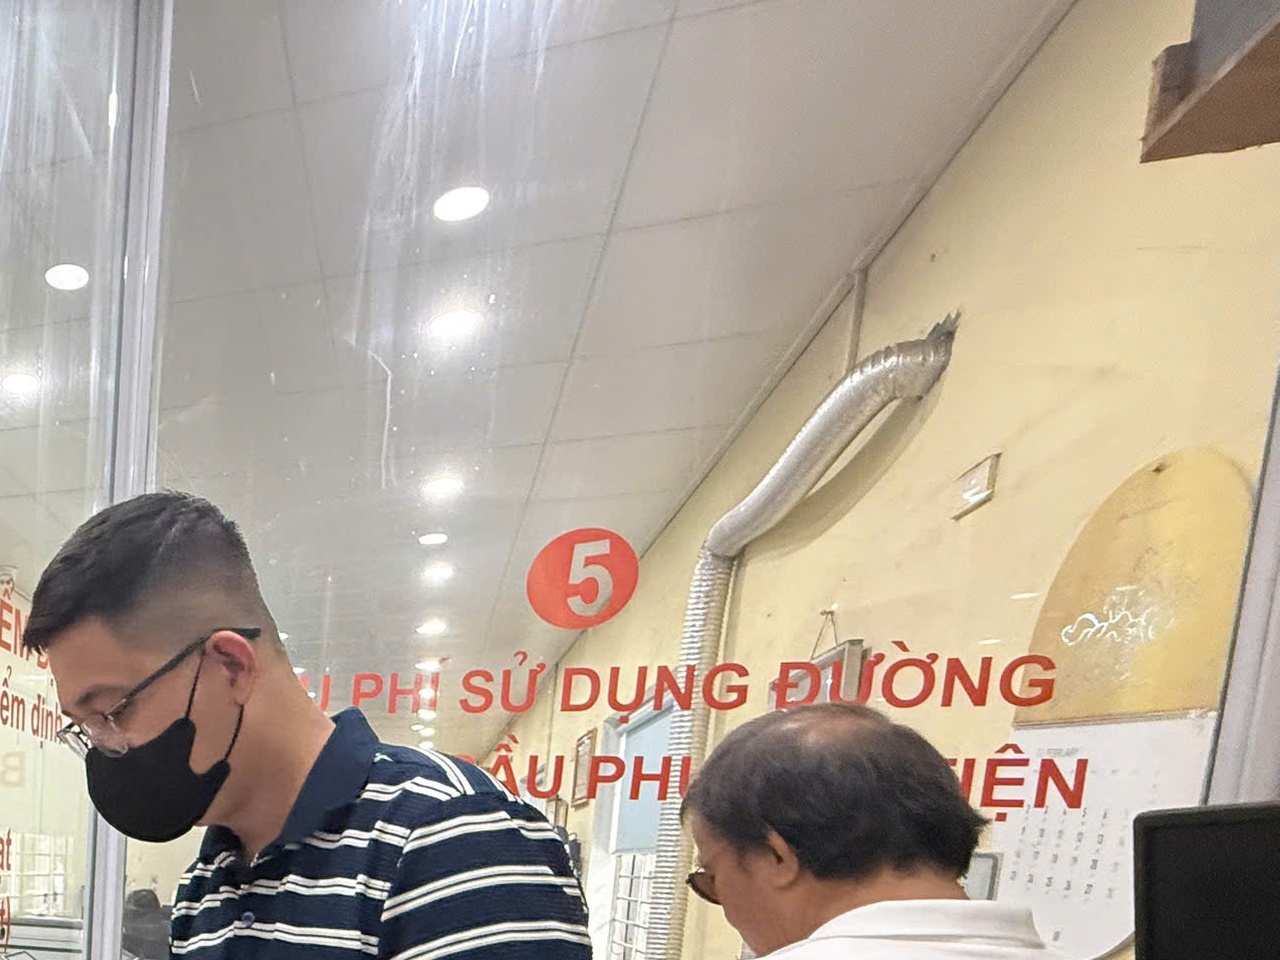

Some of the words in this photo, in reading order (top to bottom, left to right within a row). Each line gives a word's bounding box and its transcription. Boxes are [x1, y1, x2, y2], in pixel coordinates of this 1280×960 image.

[566, 539, 614, 617] 5
[352, 657, 451, 714] PHÍ
[459, 651, 546, 714] SỬ
[560, 661, 750, 724] DỤNG
[773, 640, 1058, 711] ĐƯỜNG
[455, 733, 565, 799] ẦU
[948, 743, 1089, 822] IỆN
